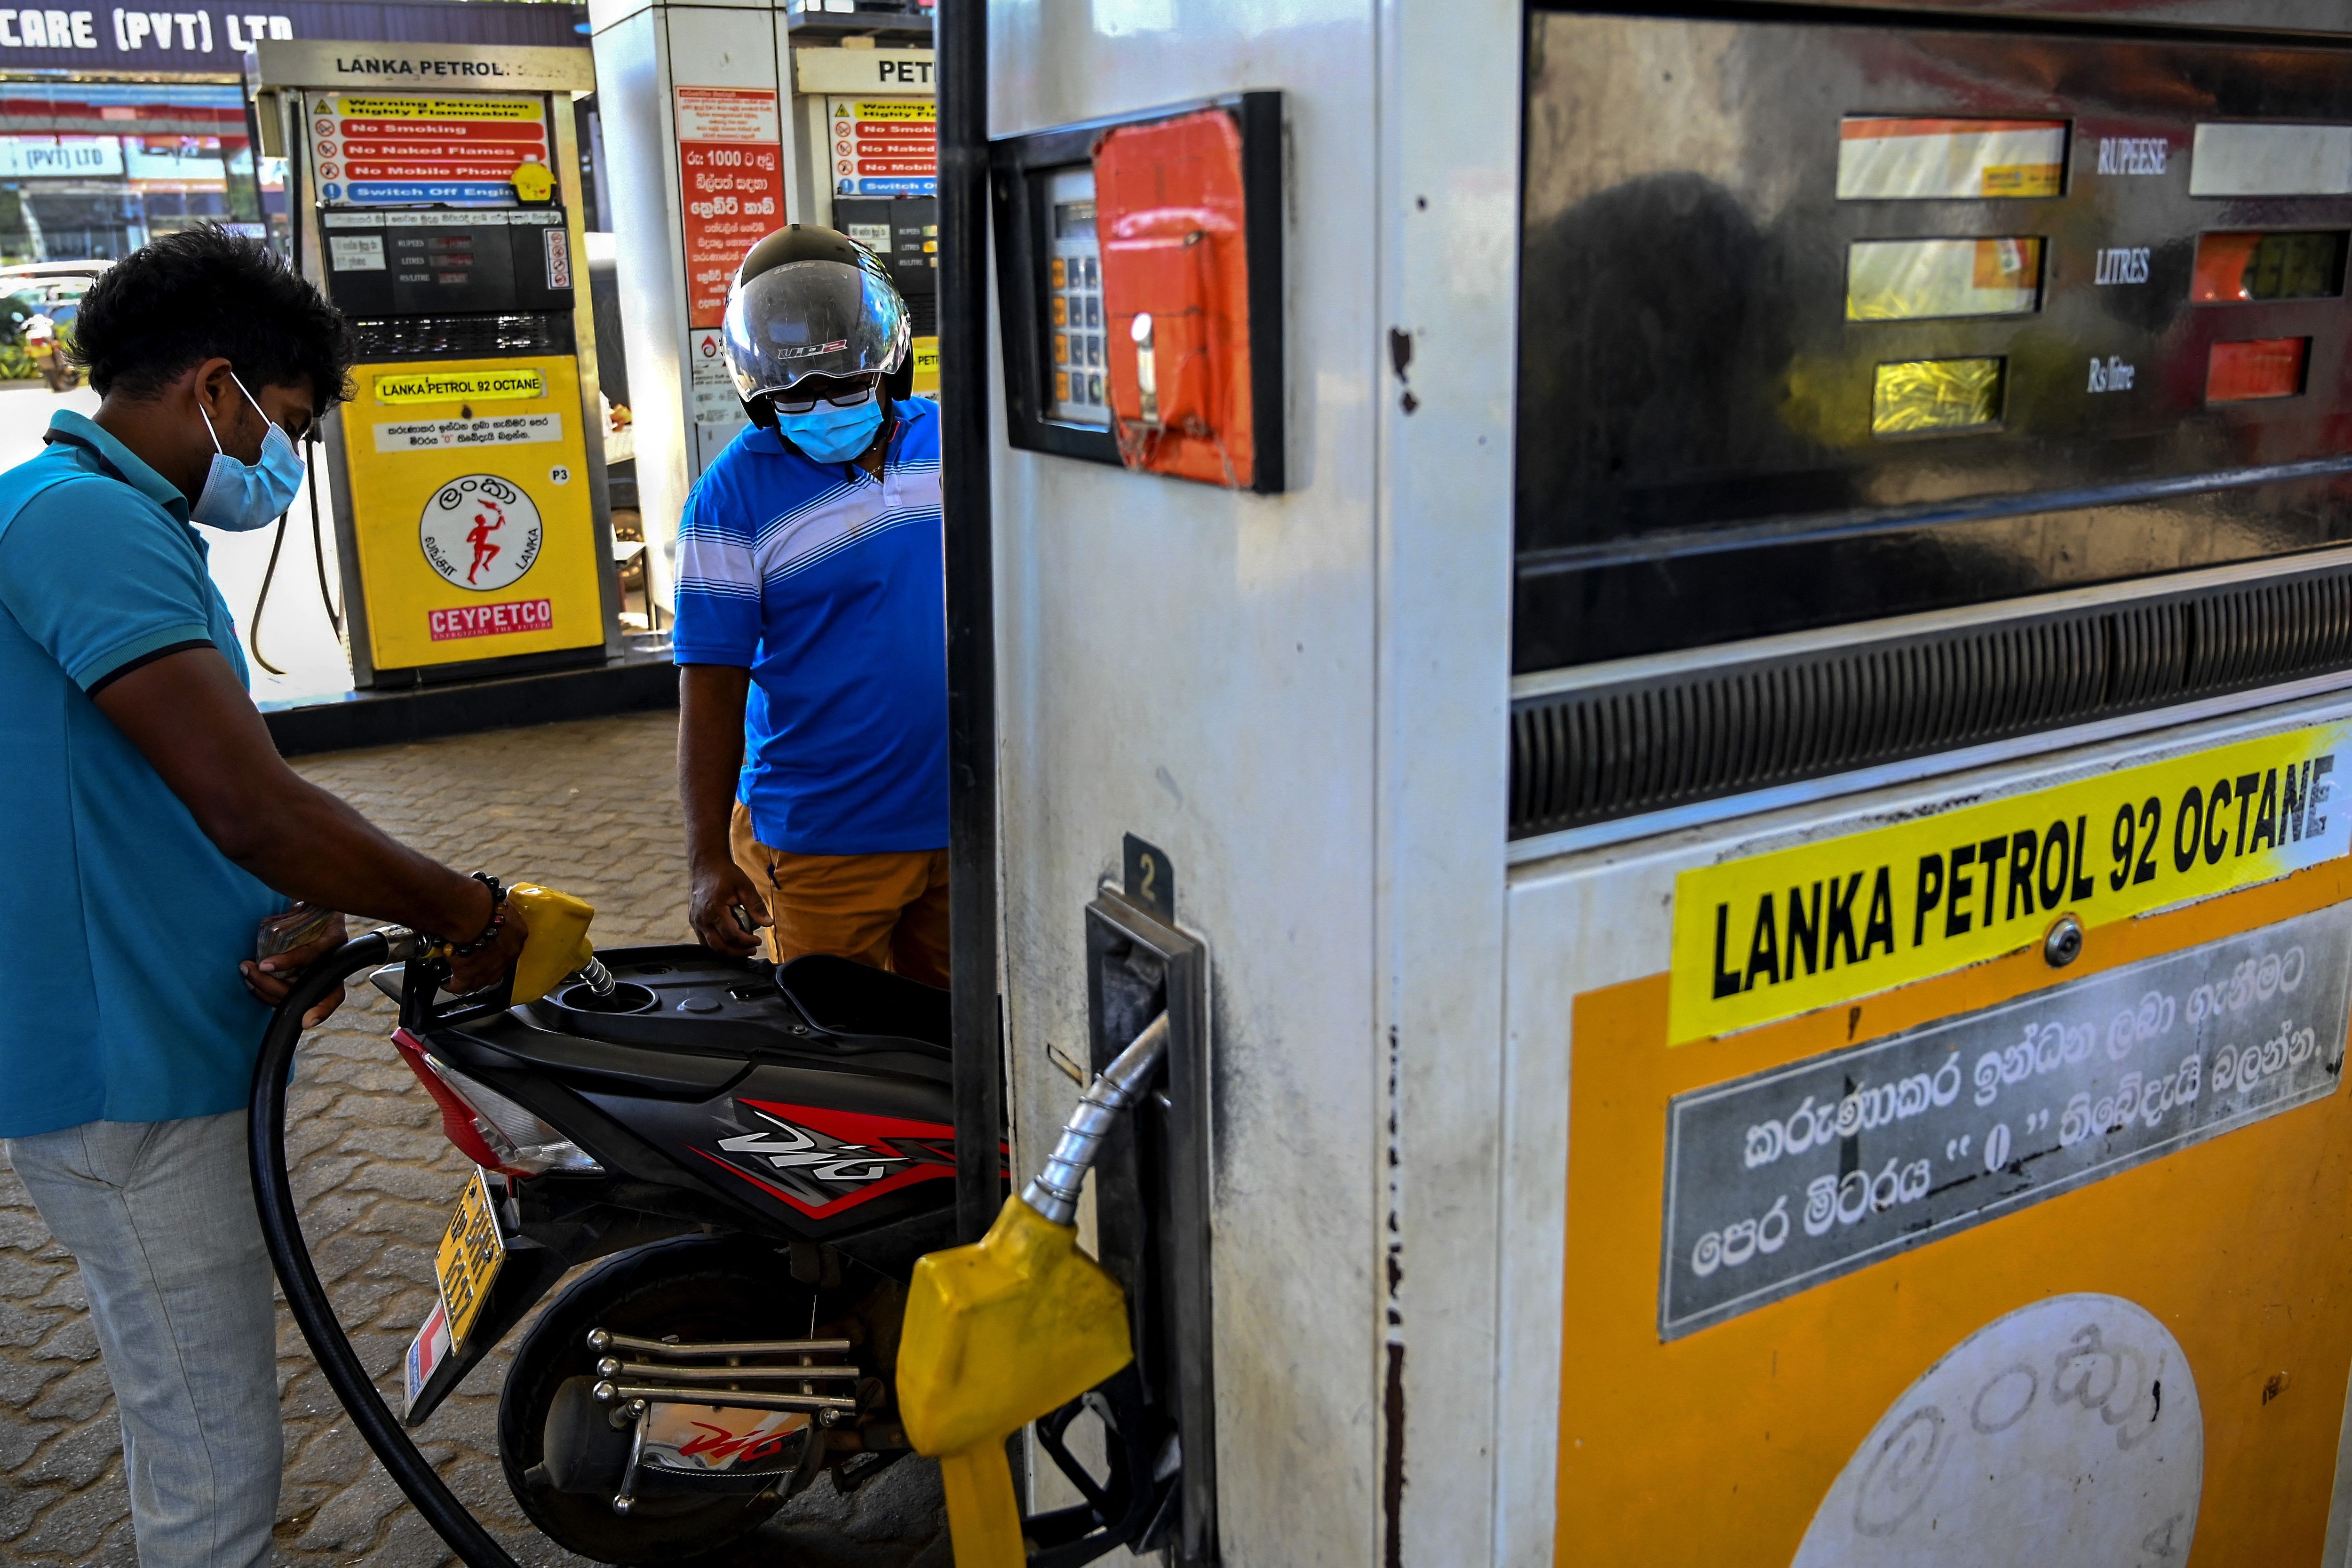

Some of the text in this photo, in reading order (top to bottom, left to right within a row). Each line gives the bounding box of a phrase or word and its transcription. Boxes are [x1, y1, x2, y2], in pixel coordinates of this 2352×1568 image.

[0, 9, 97, 48] CARE
[112, 8, 213, 53] (PVT)
[337, 58, 413, 74] LANKA
[879, 60, 936, 83] PET
[349, 99, 529, 110] Warning Petroleum
[350, 108, 520, 117] Highly Flammable
[351, 124, 467, 135] No Smoking
[26, 148, 103, 169] (PVT) LTD
[349, 145, 516, 156] No Naked Flames
[708, 150, 741, 167] 1000
[2097, 136, 2168, 175] RUPEESE
[355, 166, 513, 176] No Mobile Phone
[357, 187, 514, 199] Switch Off Engin
[2094, 247, 2150, 285] LITRES
[383, 378, 540, 397] LANKA PETROL 92 OCTANE
[472, 421, 490, 431] ලබා
[552, 469, 568, 480] P3
[439, 478, 516, 510] ලංකා
[516, 527, 539, 570] LANKA
[432, 600, 551, 633] CEYPETCO
[433, 628, 489, 639] ENERGIZING
[518, 622, 552, 630] FUTURE
[1140, 853, 1156, 902] 2
[1712, 754, 2336, 999] LANKA PETROL 92 OCTANE
[1744, 1045, 1962, 1169] කරුණාකර
[1974, 1021, 2098, 1106] ඉන්ධන
[2105, 991, 2177, 1057] ලබා
[1692, 1195, 1789, 1277] පෙර
